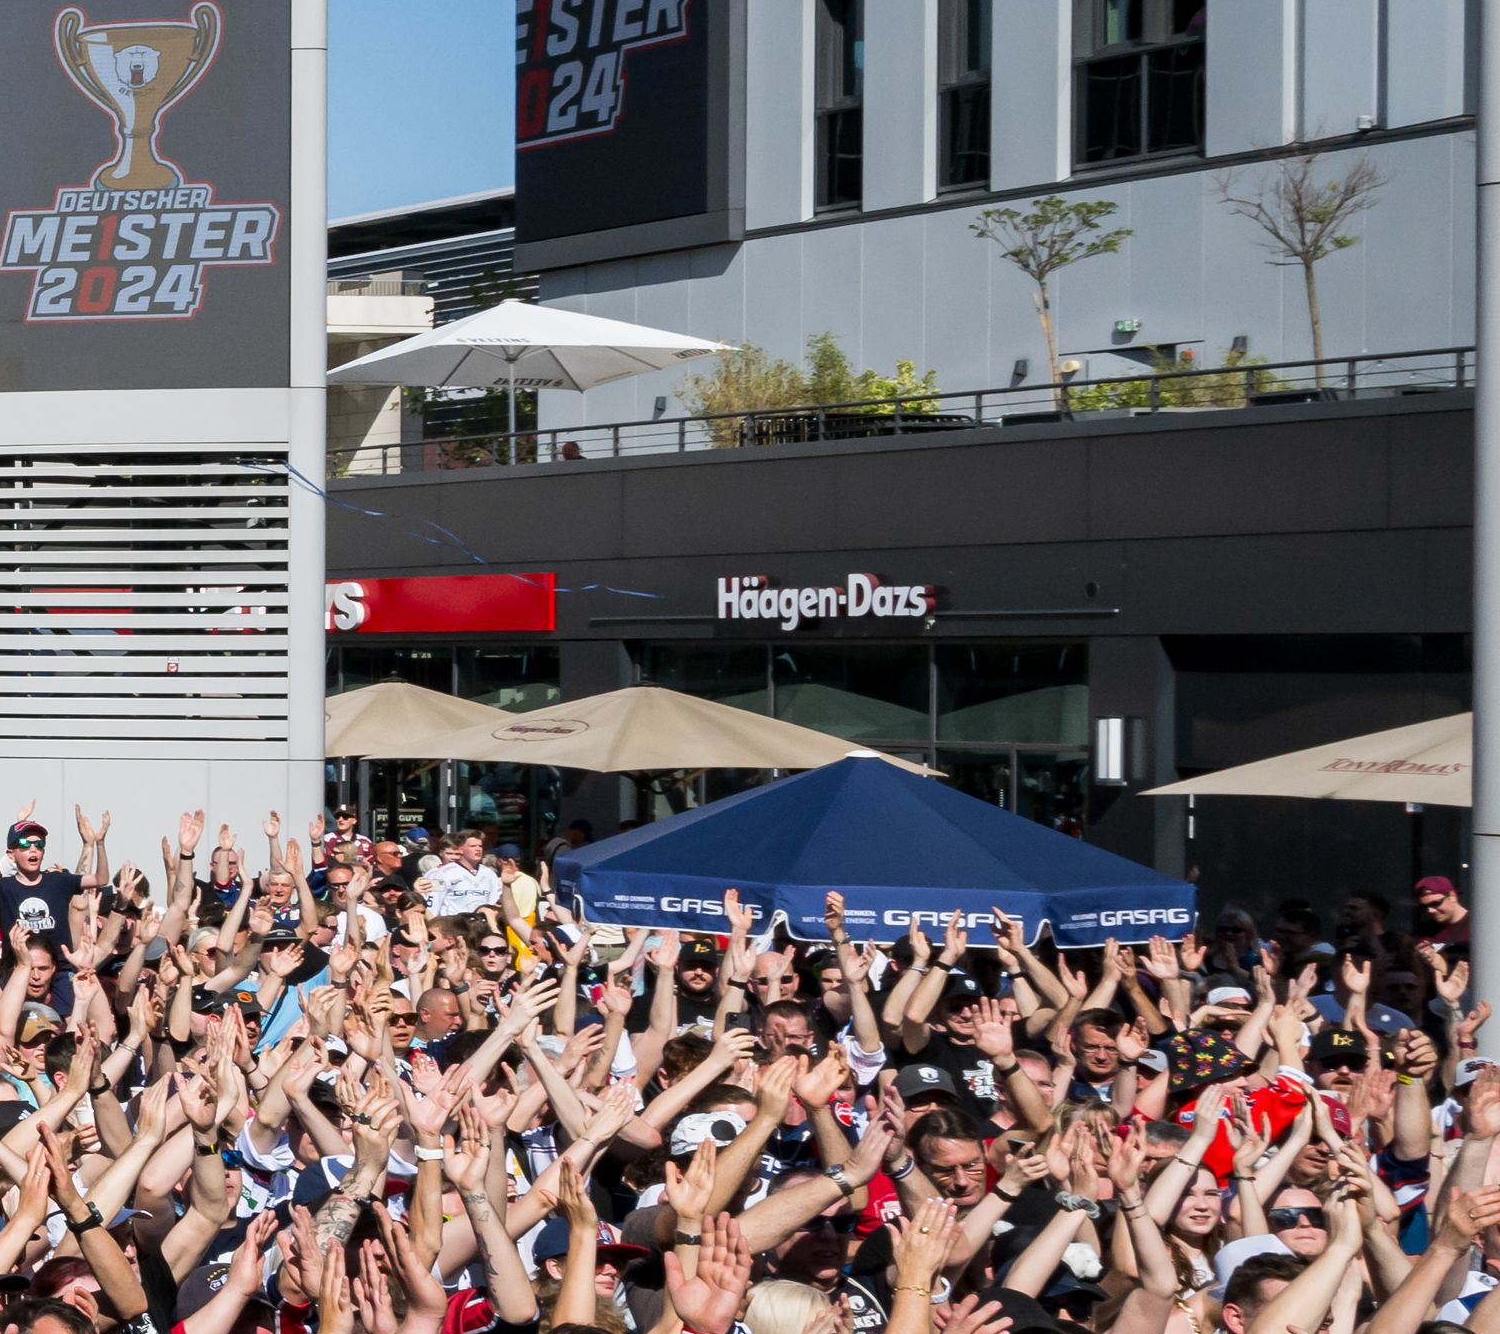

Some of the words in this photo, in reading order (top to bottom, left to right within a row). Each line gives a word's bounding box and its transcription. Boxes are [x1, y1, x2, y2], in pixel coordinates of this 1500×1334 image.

[60, 189, 209, 214] DEUTSCHER
[36, 265, 200, 316] 2024
[717, 573, 928, 631] Häagen-Dazs
[1100, 908, 1190, 928] GASAG
